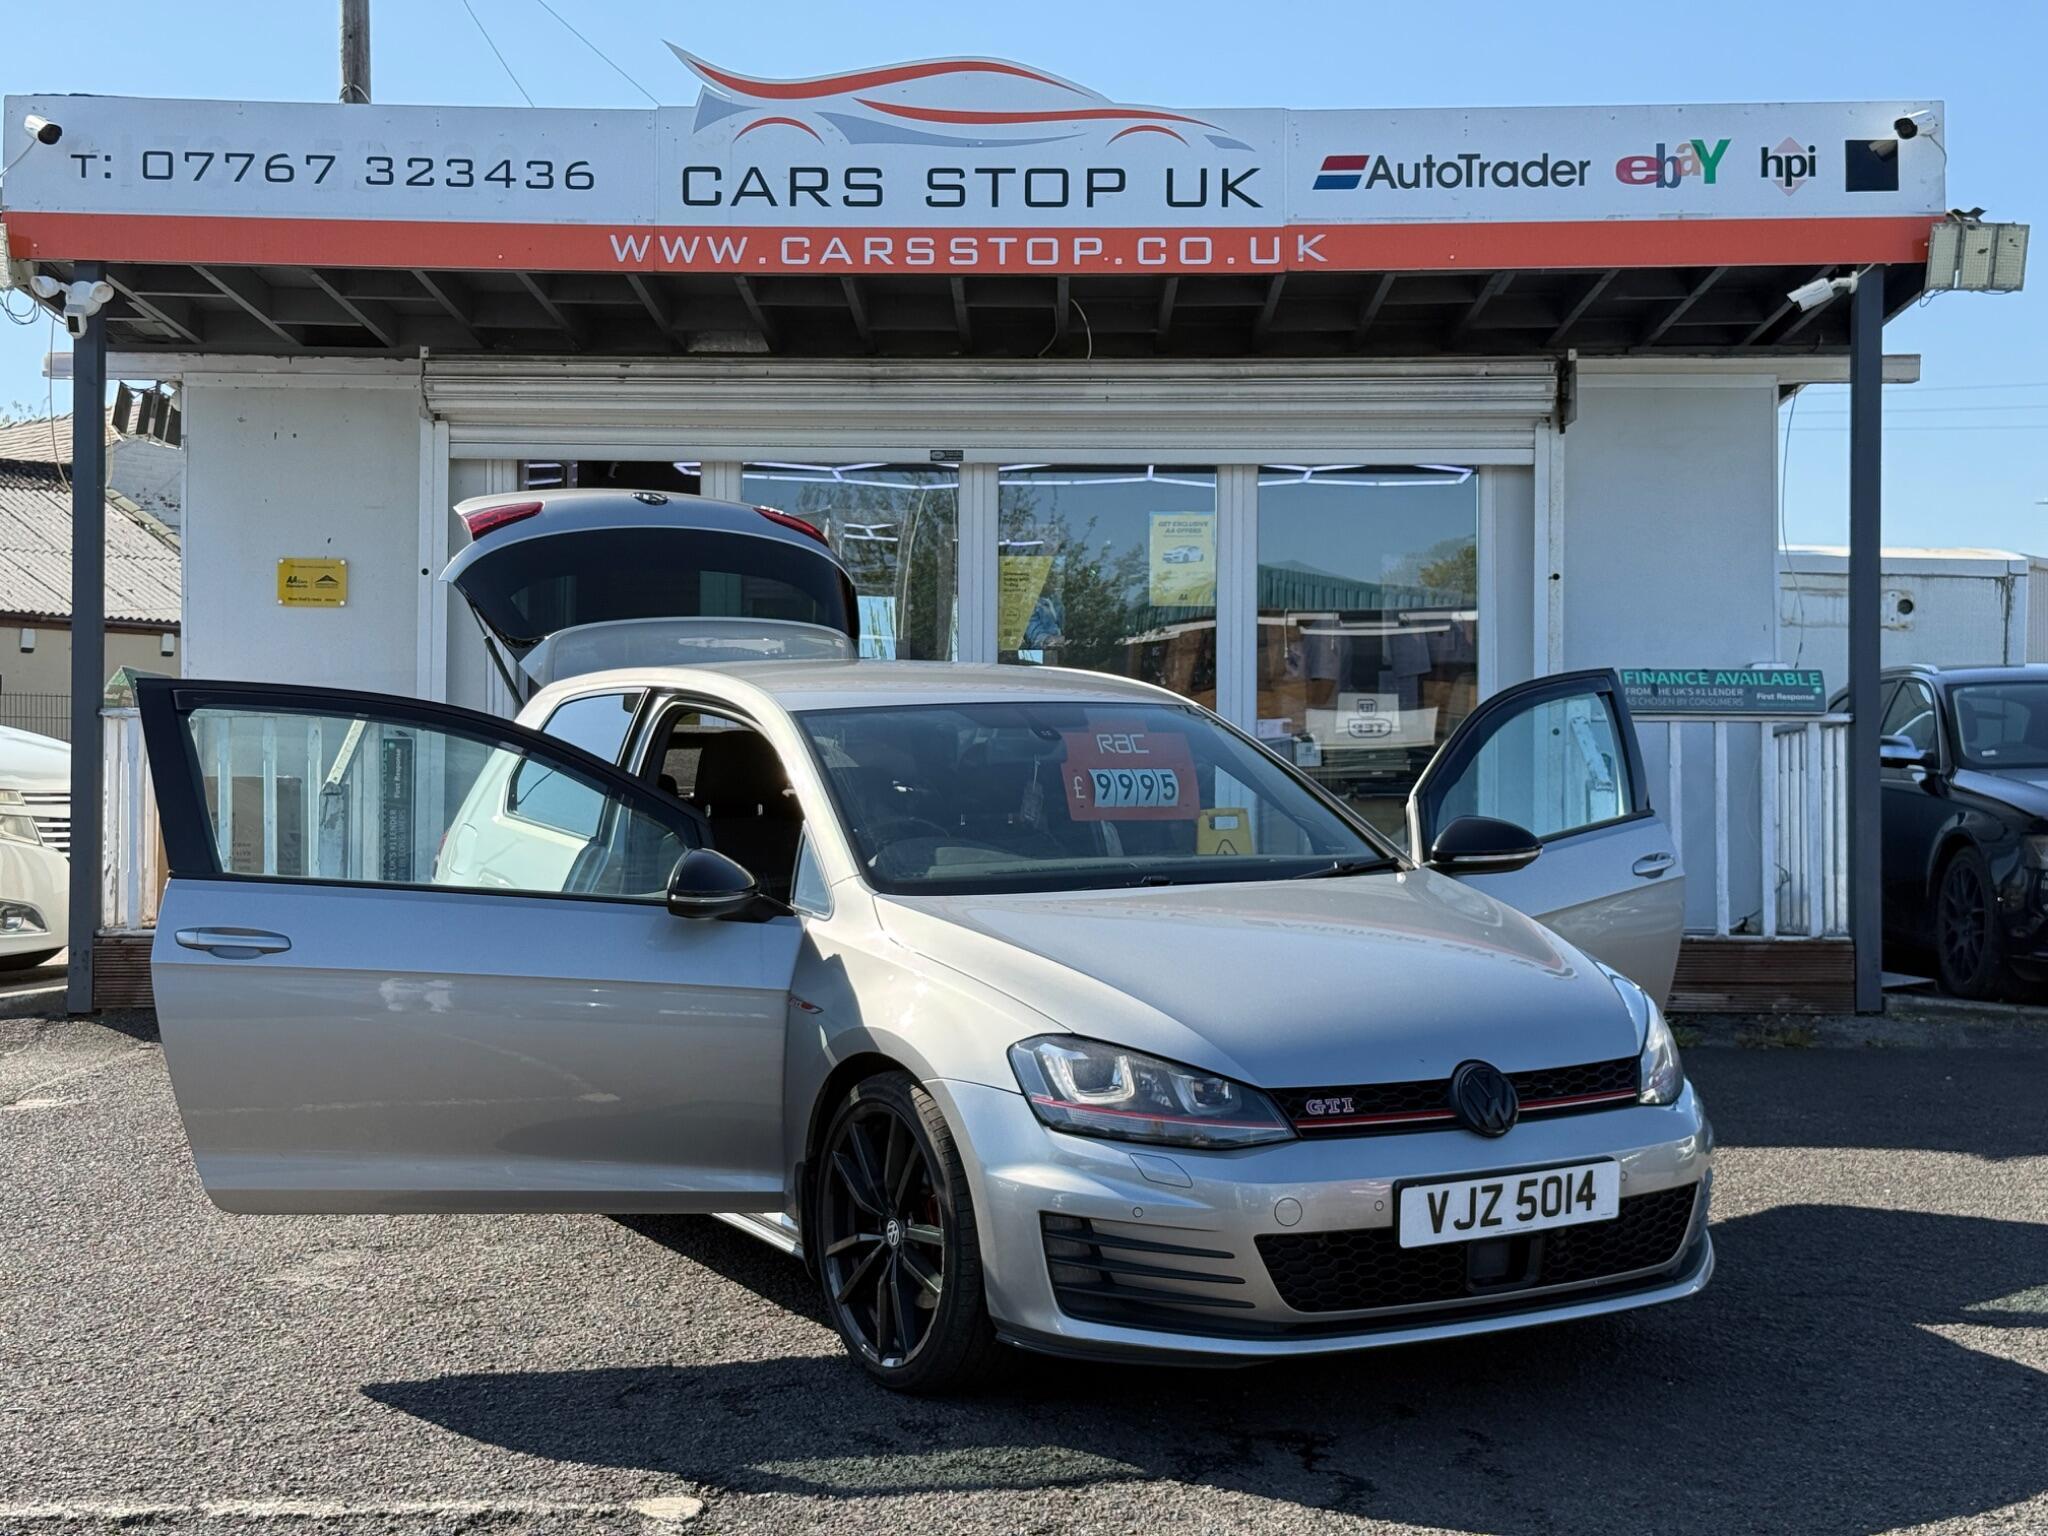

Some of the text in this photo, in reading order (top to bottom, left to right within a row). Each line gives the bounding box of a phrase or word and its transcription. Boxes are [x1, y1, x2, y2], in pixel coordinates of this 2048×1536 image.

[70, 153, 112, 179] T:
[142, 150, 336, 185] 07767
[365, 155, 595, 191] 323436
[1365, 153, 1591, 190] AutoTrader
[1761, 146, 1816, 186] hpi
[682, 166, 1263, 208] CARS STOP UK
[609, 233, 1328, 266] WWW.CARSSTOP.CO.UK
[1623, 671, 1821, 687] FINANCE AVAILABLE
[1625, 687, 1651, 696] FROM
[1652, 687, 1672, 696] HE
[1673, 687, 1694, 696] UK'S
[1708, 687, 1744, 697] LENDER
[1638, 697, 1675, 705] CHOSEN
[1689, 697, 1745, 706] CONSUMERS
[1756, 692, 1816, 701] First Response
[1305, 1097, 1354, 1116] GTI
[1426, 1169, 1596, 1234] VJZ 5014
